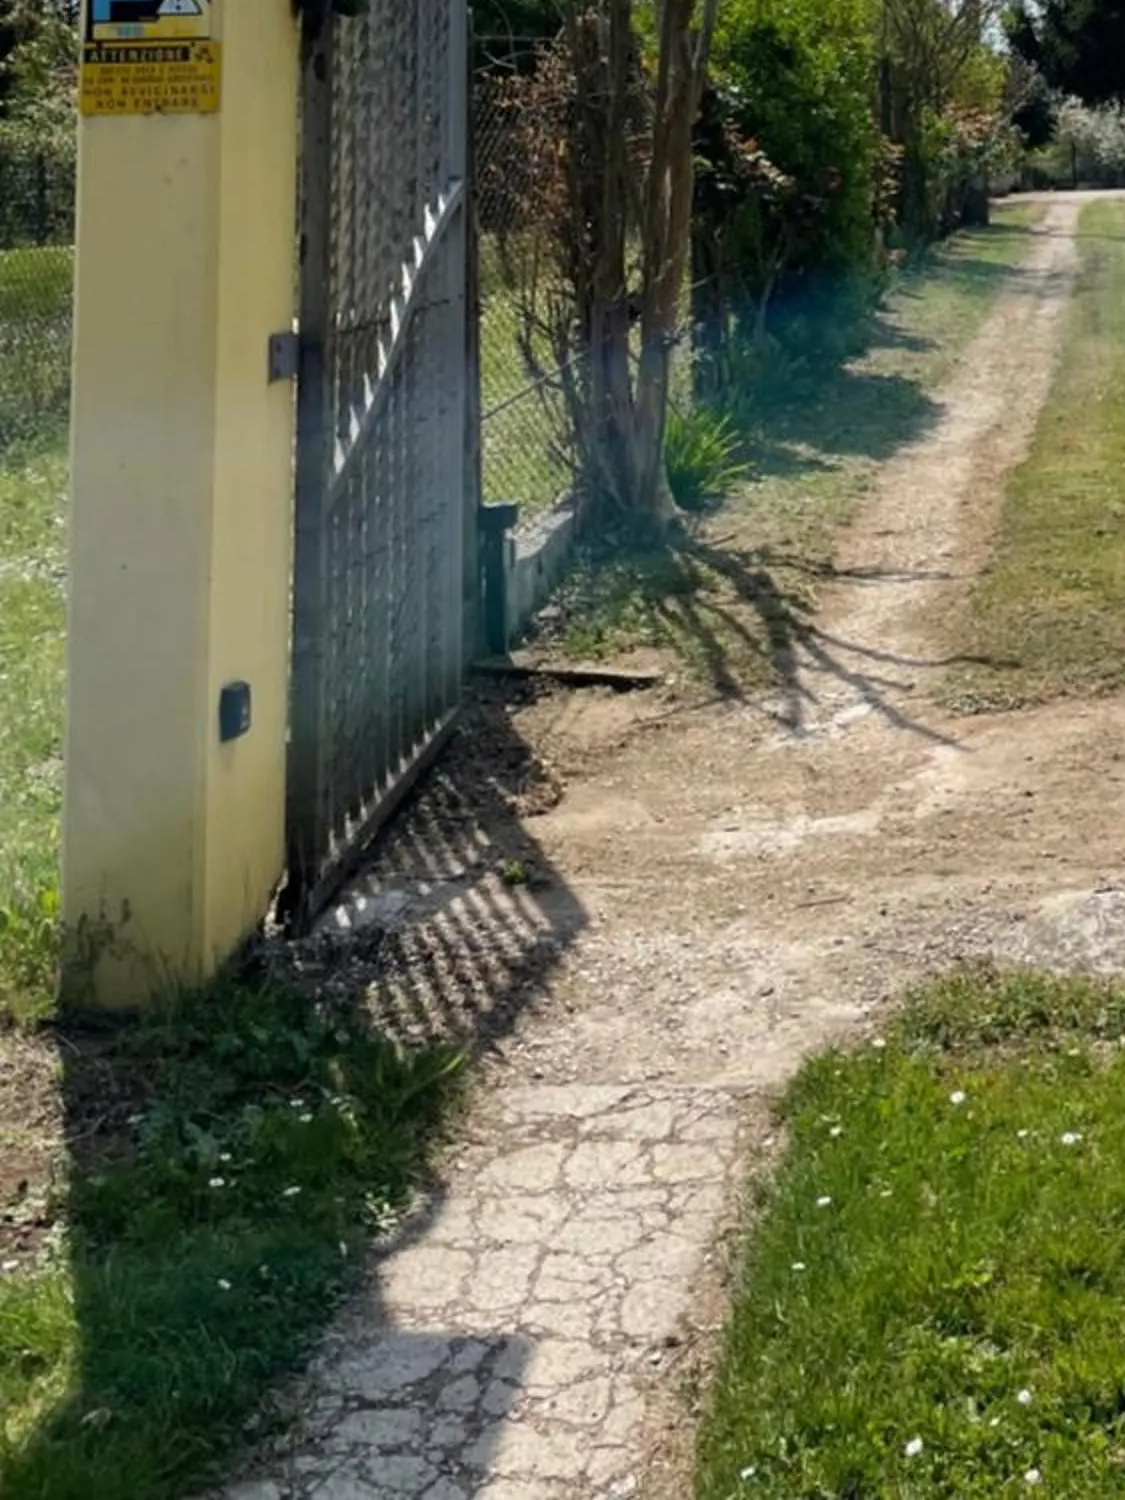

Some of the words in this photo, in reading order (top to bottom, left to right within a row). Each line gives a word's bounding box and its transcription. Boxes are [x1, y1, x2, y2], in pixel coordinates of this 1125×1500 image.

[89, 49, 183, 62] ATTENZIONE
[83, 87, 112, 97] NON
[121, 84, 215, 97] AVVICINARSI
[96, 99, 126, 109] NON
[133, 97, 198, 109] ENTRARE
